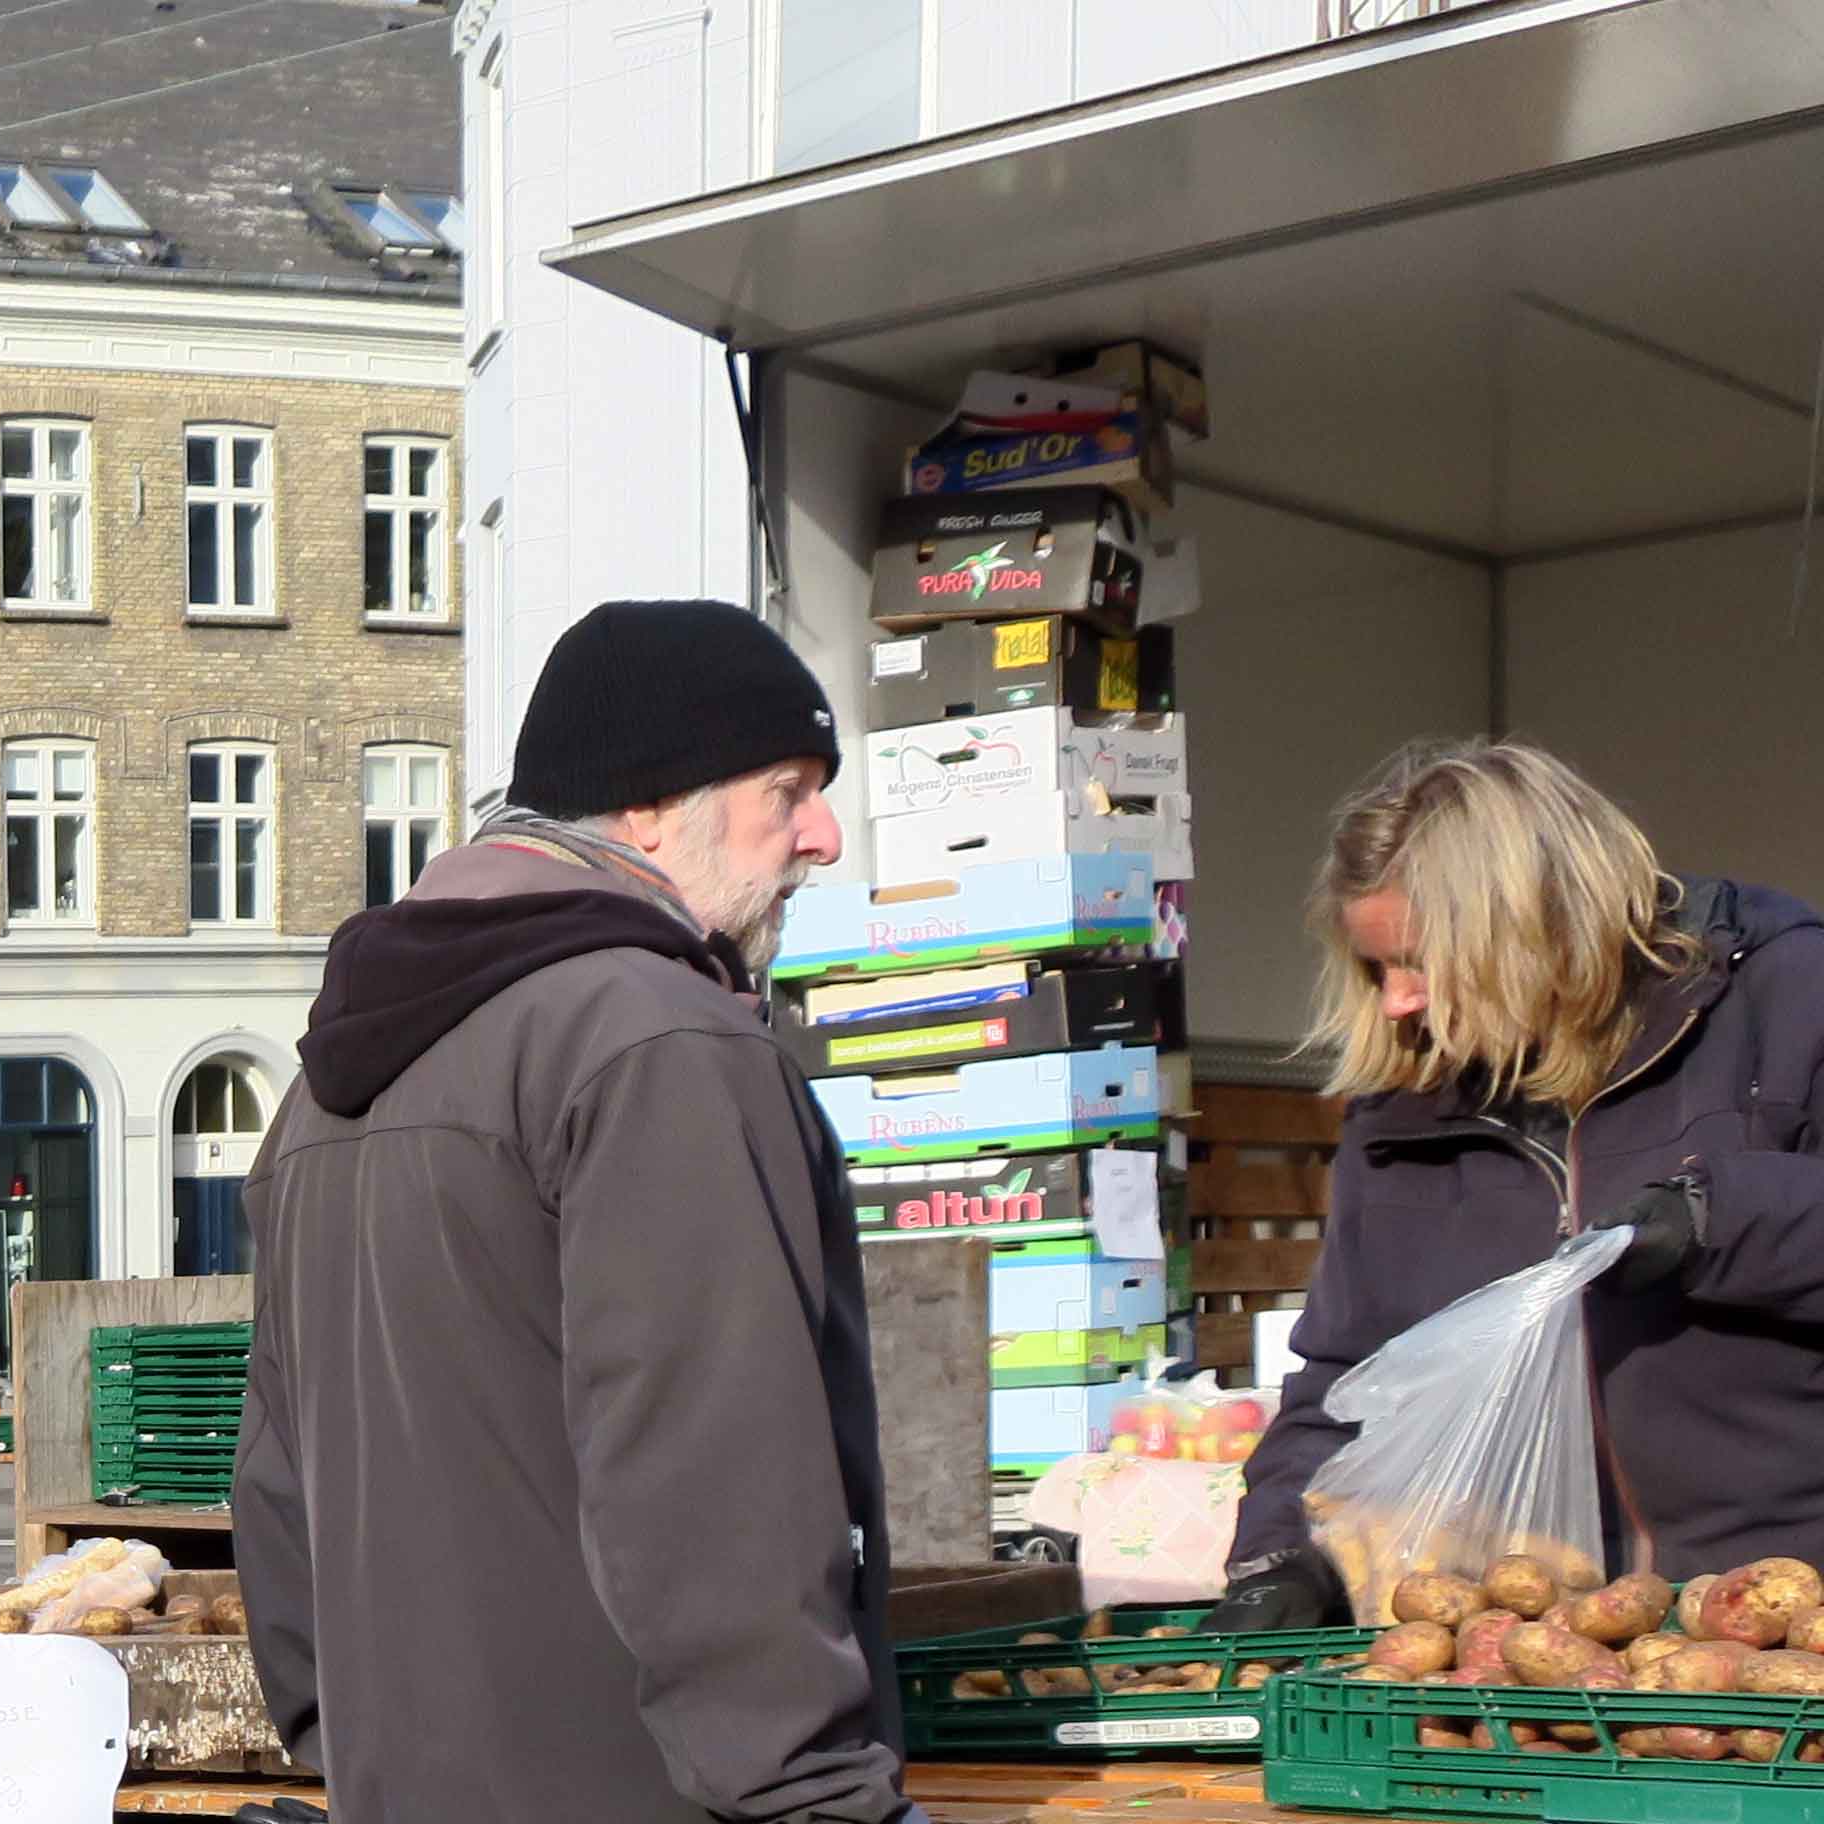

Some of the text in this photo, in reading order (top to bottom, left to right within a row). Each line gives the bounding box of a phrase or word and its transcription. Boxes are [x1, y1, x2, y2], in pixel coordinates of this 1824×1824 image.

[963, 433, 1082, 479] Sud'Or
[919, 569, 1042, 594] PURA VIDA
[887, 779, 943, 797] Mogens
[865, 916, 969, 959] RUBENS
[868, 1111, 967, 1152] RUBENS
[896, 1190, 1043, 1230] altun
